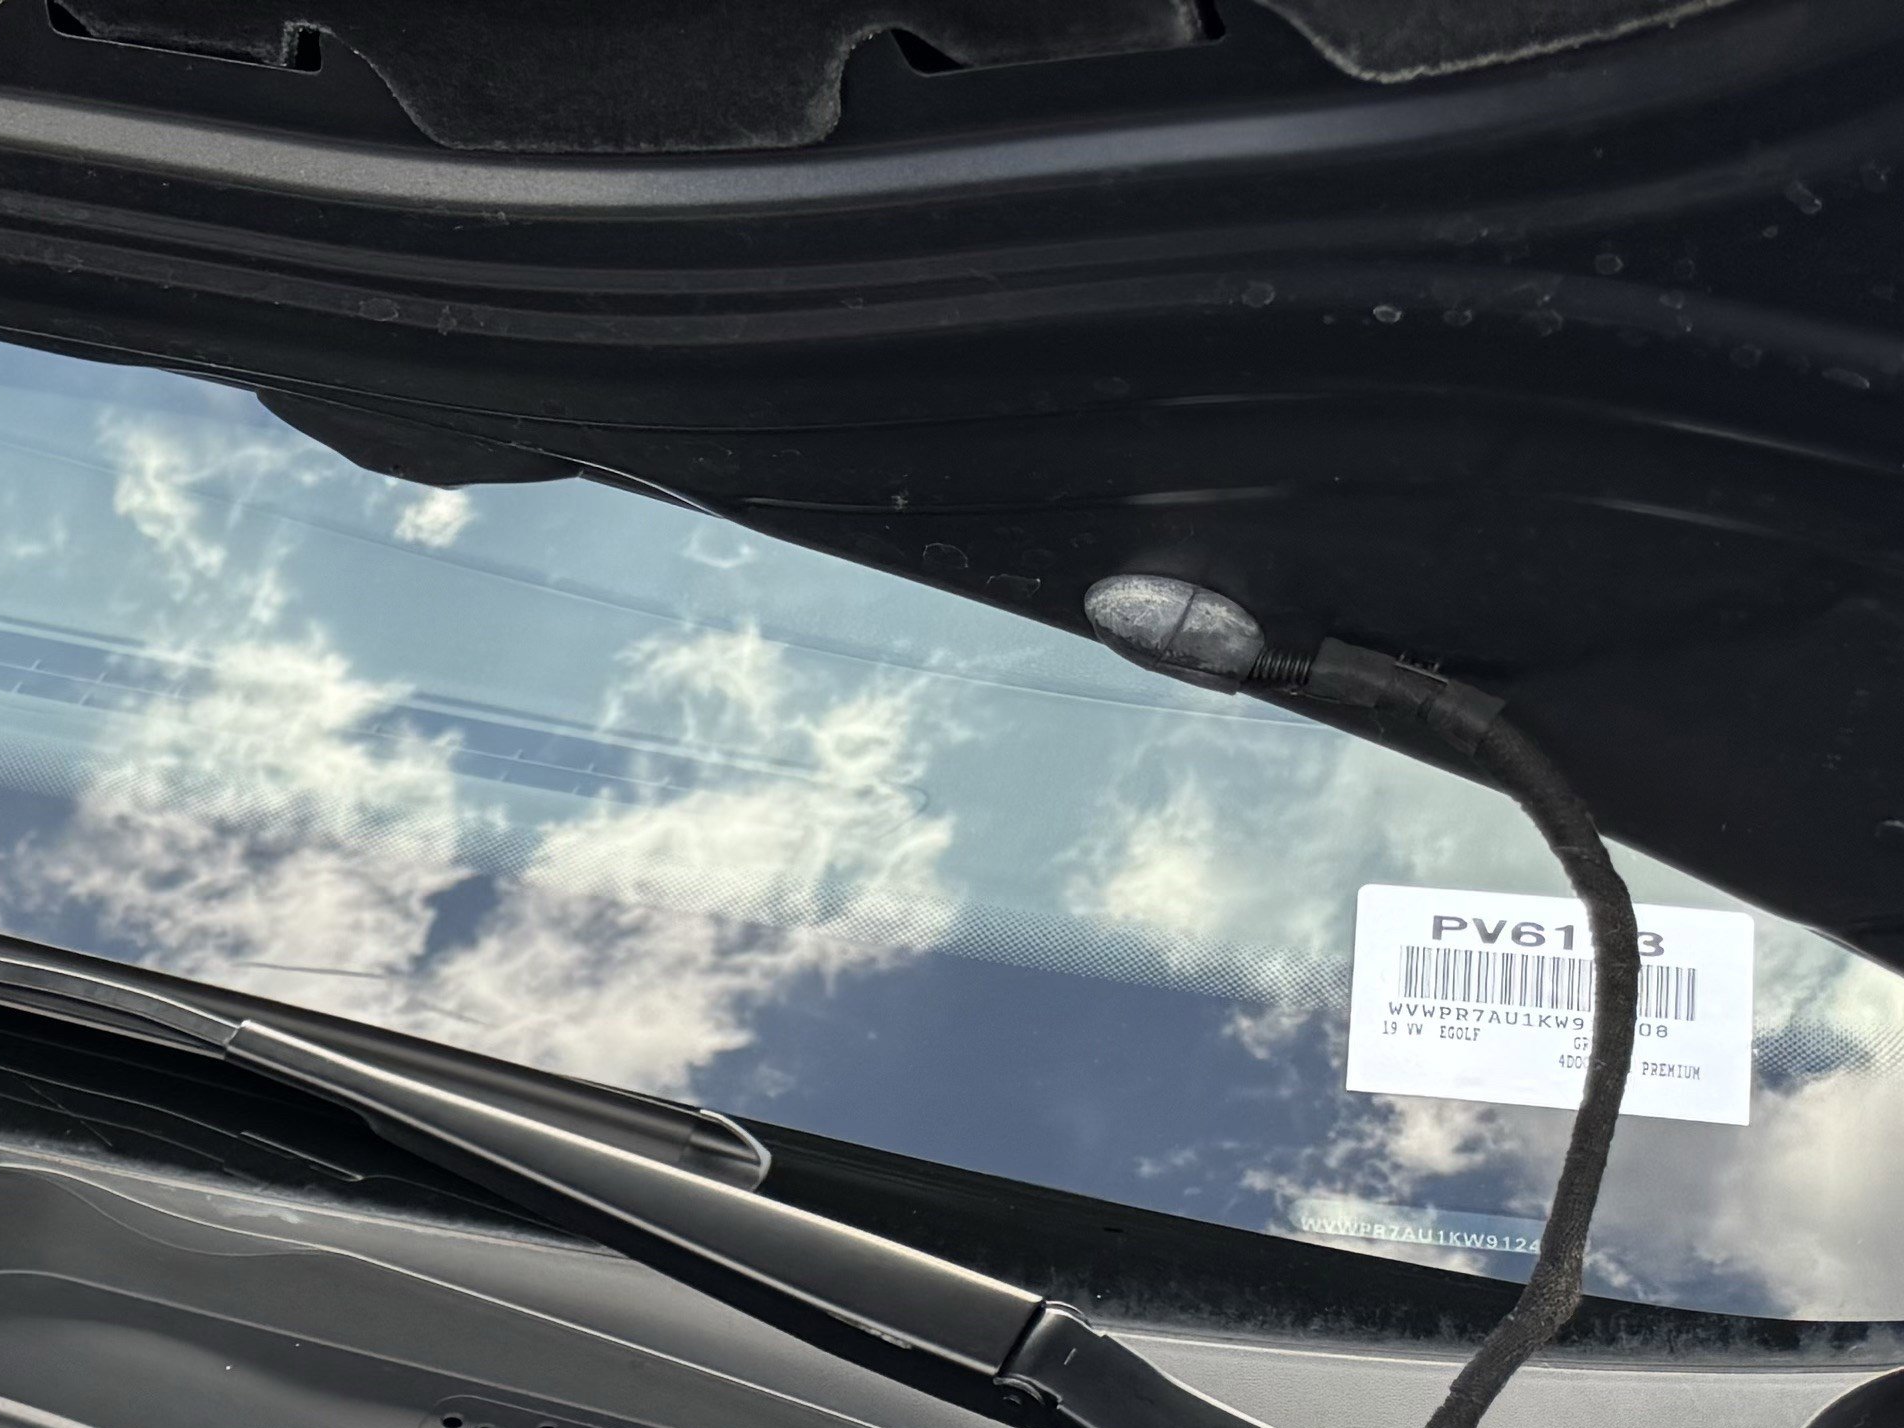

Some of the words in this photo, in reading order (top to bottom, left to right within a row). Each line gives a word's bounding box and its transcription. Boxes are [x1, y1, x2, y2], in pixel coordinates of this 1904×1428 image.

[1433, 915, 1665, 957] PV613
[1382, 1020, 1398, 1035] 19
[1407, 1022, 1423, 1036] VW
[1440, 1025, 1481, 1042] EGOLF
[1389, 1002, 1669, 1038] WVWPR7AU1KW908
[1642, 1061, 1701, 1081] PREMIUM
